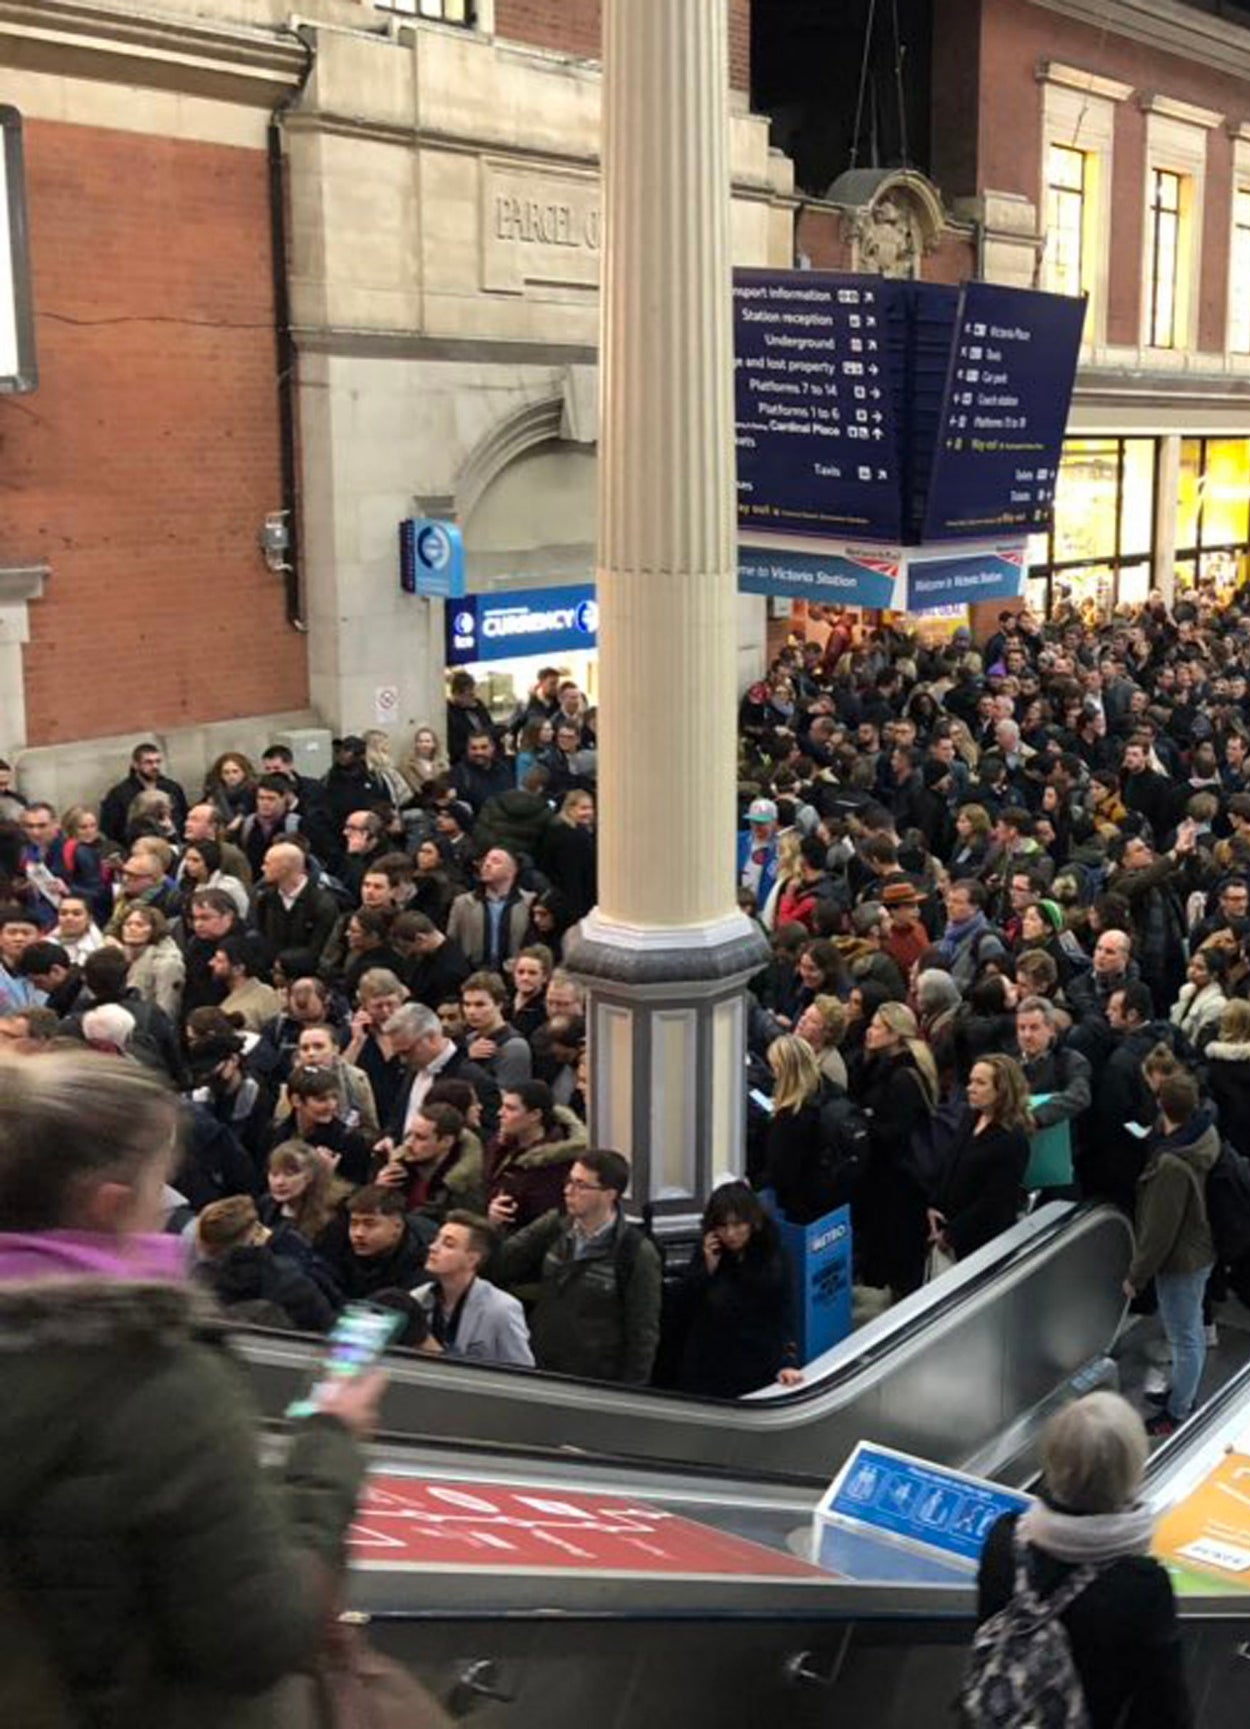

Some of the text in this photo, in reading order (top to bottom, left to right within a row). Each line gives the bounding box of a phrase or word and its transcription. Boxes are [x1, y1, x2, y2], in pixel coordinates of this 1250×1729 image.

[496, 196, 581, 248] PARCEL
[769, 286, 831, 302] information
[742, 307, 833, 326] Station reception
[764, 333, 835, 350] Underground
[746, 356, 765, 369] and
[766, 356, 786, 370] lost
[788, 360, 836, 376] property
[749, 378, 800, 395] Platforms
[811, 384, 823, 396] to
[825, 383, 838, 397] 14
[758, 403, 808, 417] Platforms
[818, 407, 830, 419] to
[831, 407, 840, 420] 6
[769, 420, 811, 434] Cardinal
[813, 423, 840, 436] Place
[814, 463, 841, 477] Taxis
[757, 566, 769, 577] to
[771, 564, 814, 583] Victoria
[815, 571, 858, 588] Station
[812, 1224, 847, 1252] METRO
